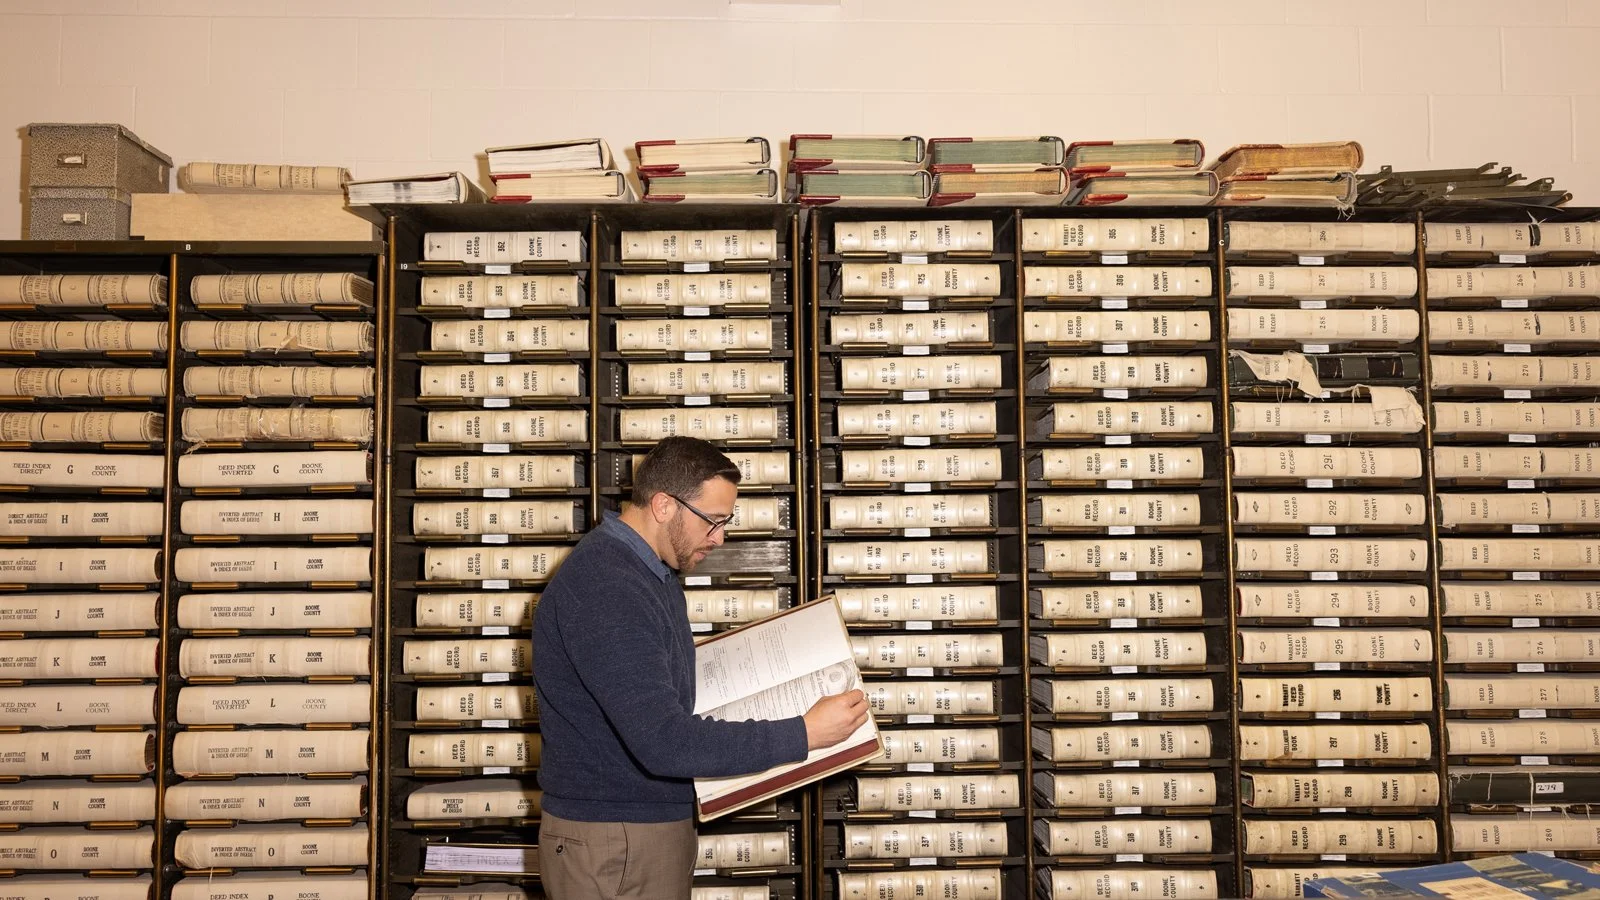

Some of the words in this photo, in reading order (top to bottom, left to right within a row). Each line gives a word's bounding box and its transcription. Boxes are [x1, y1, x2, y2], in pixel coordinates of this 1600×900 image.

[1116, 274, 1124, 286] 306
[495, 286, 503, 296] 363
[1115, 320, 1123, 331] 307
[496, 376, 504, 387] 365
[1120, 459, 1128, 468] 310
[1324, 454, 1334, 470] 291
[67, 465, 73, 474] G
[273, 465, 279, 474] G
[1329, 500, 1337, 516] 292
[61, 515, 68, 524] H
[274, 512, 280, 521] H
[1330, 548, 1338, 564] 293
[1331, 593, 1339, 608] 294
[55, 610, 60, 619] J
[271, 607, 275, 616] J
[1123, 645, 1131, 654] 314
[1335, 639, 1344, 655] 295
[53, 657, 60, 667] K
[269, 654, 276, 663] K
[480, 652, 488, 662] 371
[1128, 692, 1136, 701] 315
[1333, 689, 1341, 700] 296
[57, 702, 62, 712] L
[270, 698, 276, 707] L
[494, 698, 502, 709] 372
[1131, 738, 1139, 747] 316
[1329, 737, 1337, 748] 297
[265, 749, 273, 758] M
[486, 745, 494, 757] 373
[41, 752, 49, 761] M
[1344, 786, 1352, 797] 298
[52, 801, 59, 810] N
[259, 799, 265, 807] N
[485, 802, 490, 812] A
[921, 836, 929, 848] 337
[1127, 833, 1135, 842] 318
[1339, 834, 1347, 846] 299
[51, 849, 57, 859] O
[268, 848, 275, 857] O
[1131, 882, 1139, 892] 319
